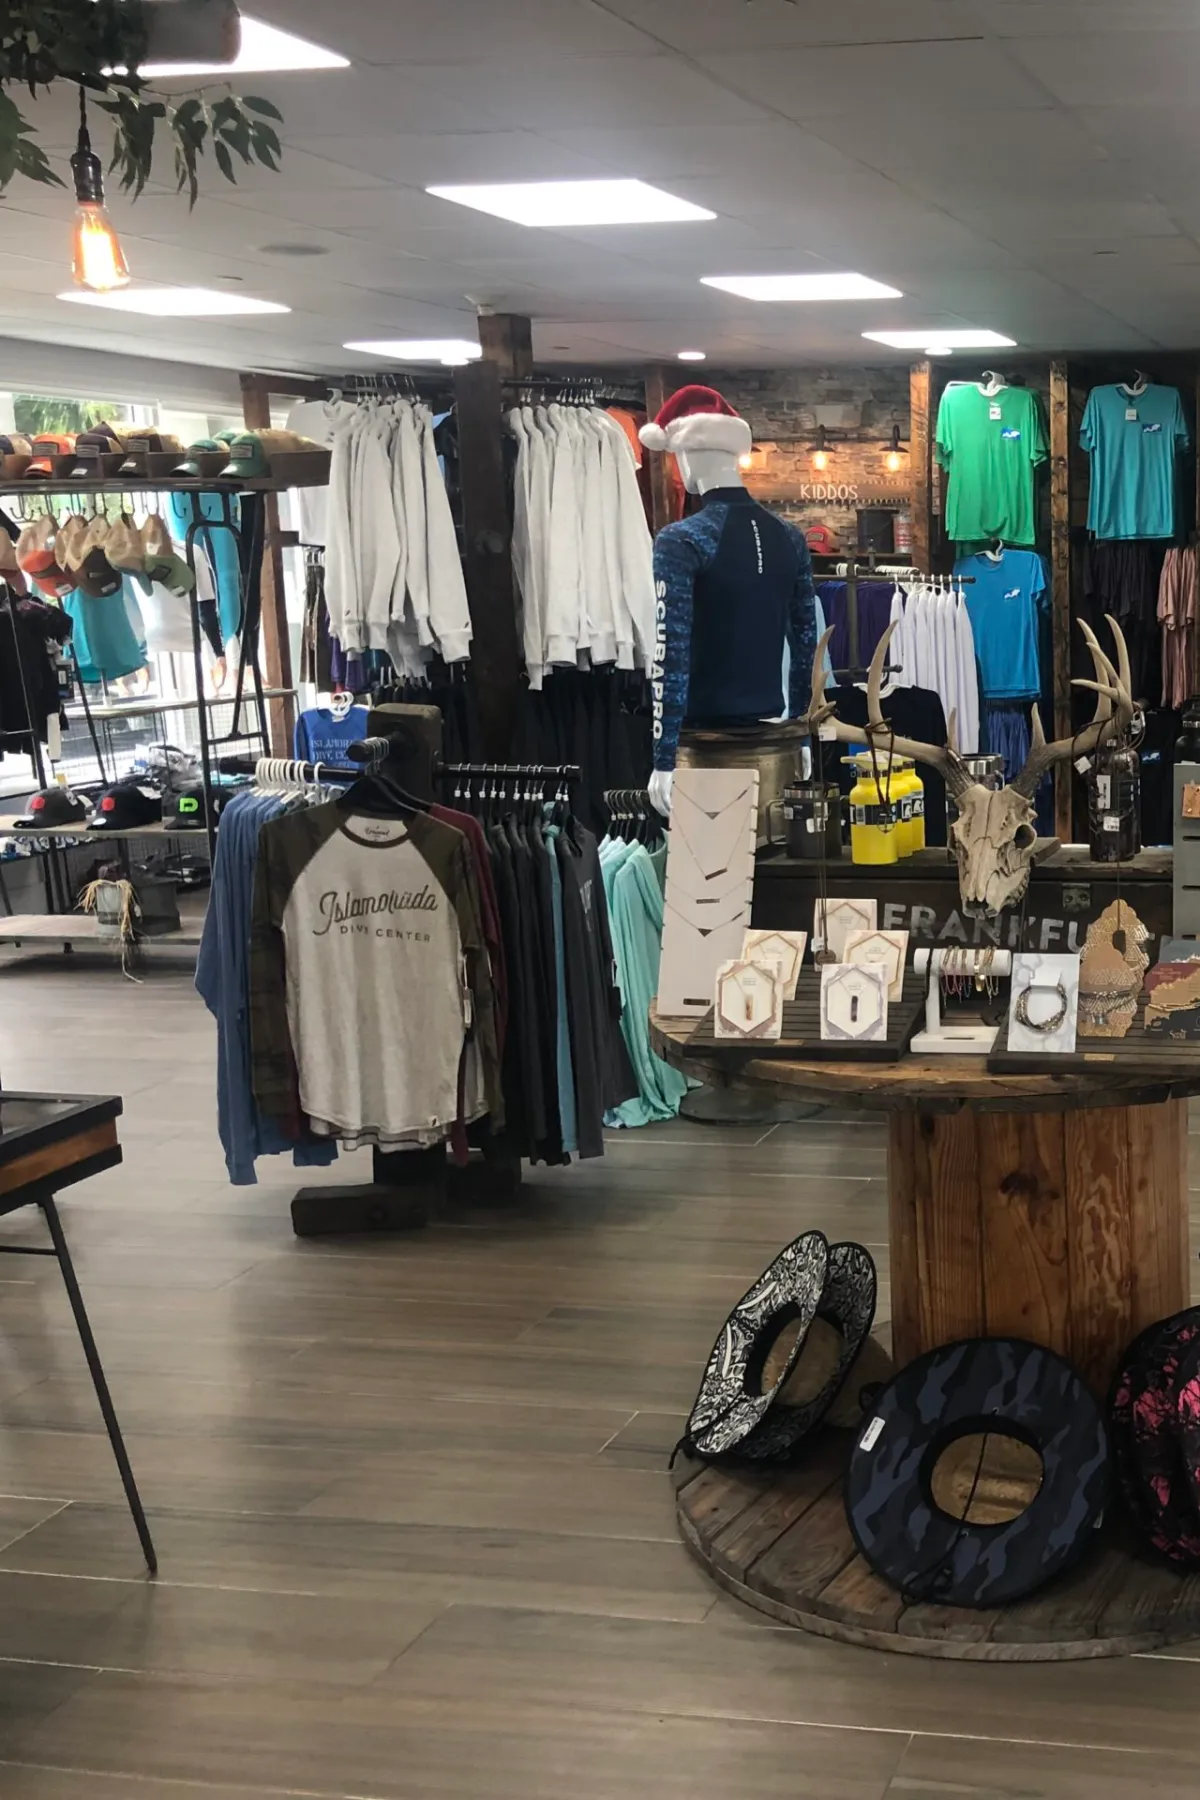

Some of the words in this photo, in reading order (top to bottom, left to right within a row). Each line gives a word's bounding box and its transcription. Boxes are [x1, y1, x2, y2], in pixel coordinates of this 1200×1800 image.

[800, 484, 858, 499] KIDDOS
[751, 519, 763, 574] SCUBAPRO
[652, 580, 667, 740] SCUBAPRO
[312, 884, 438, 935] Islamorada
[376, 928, 431, 942] CENTER
